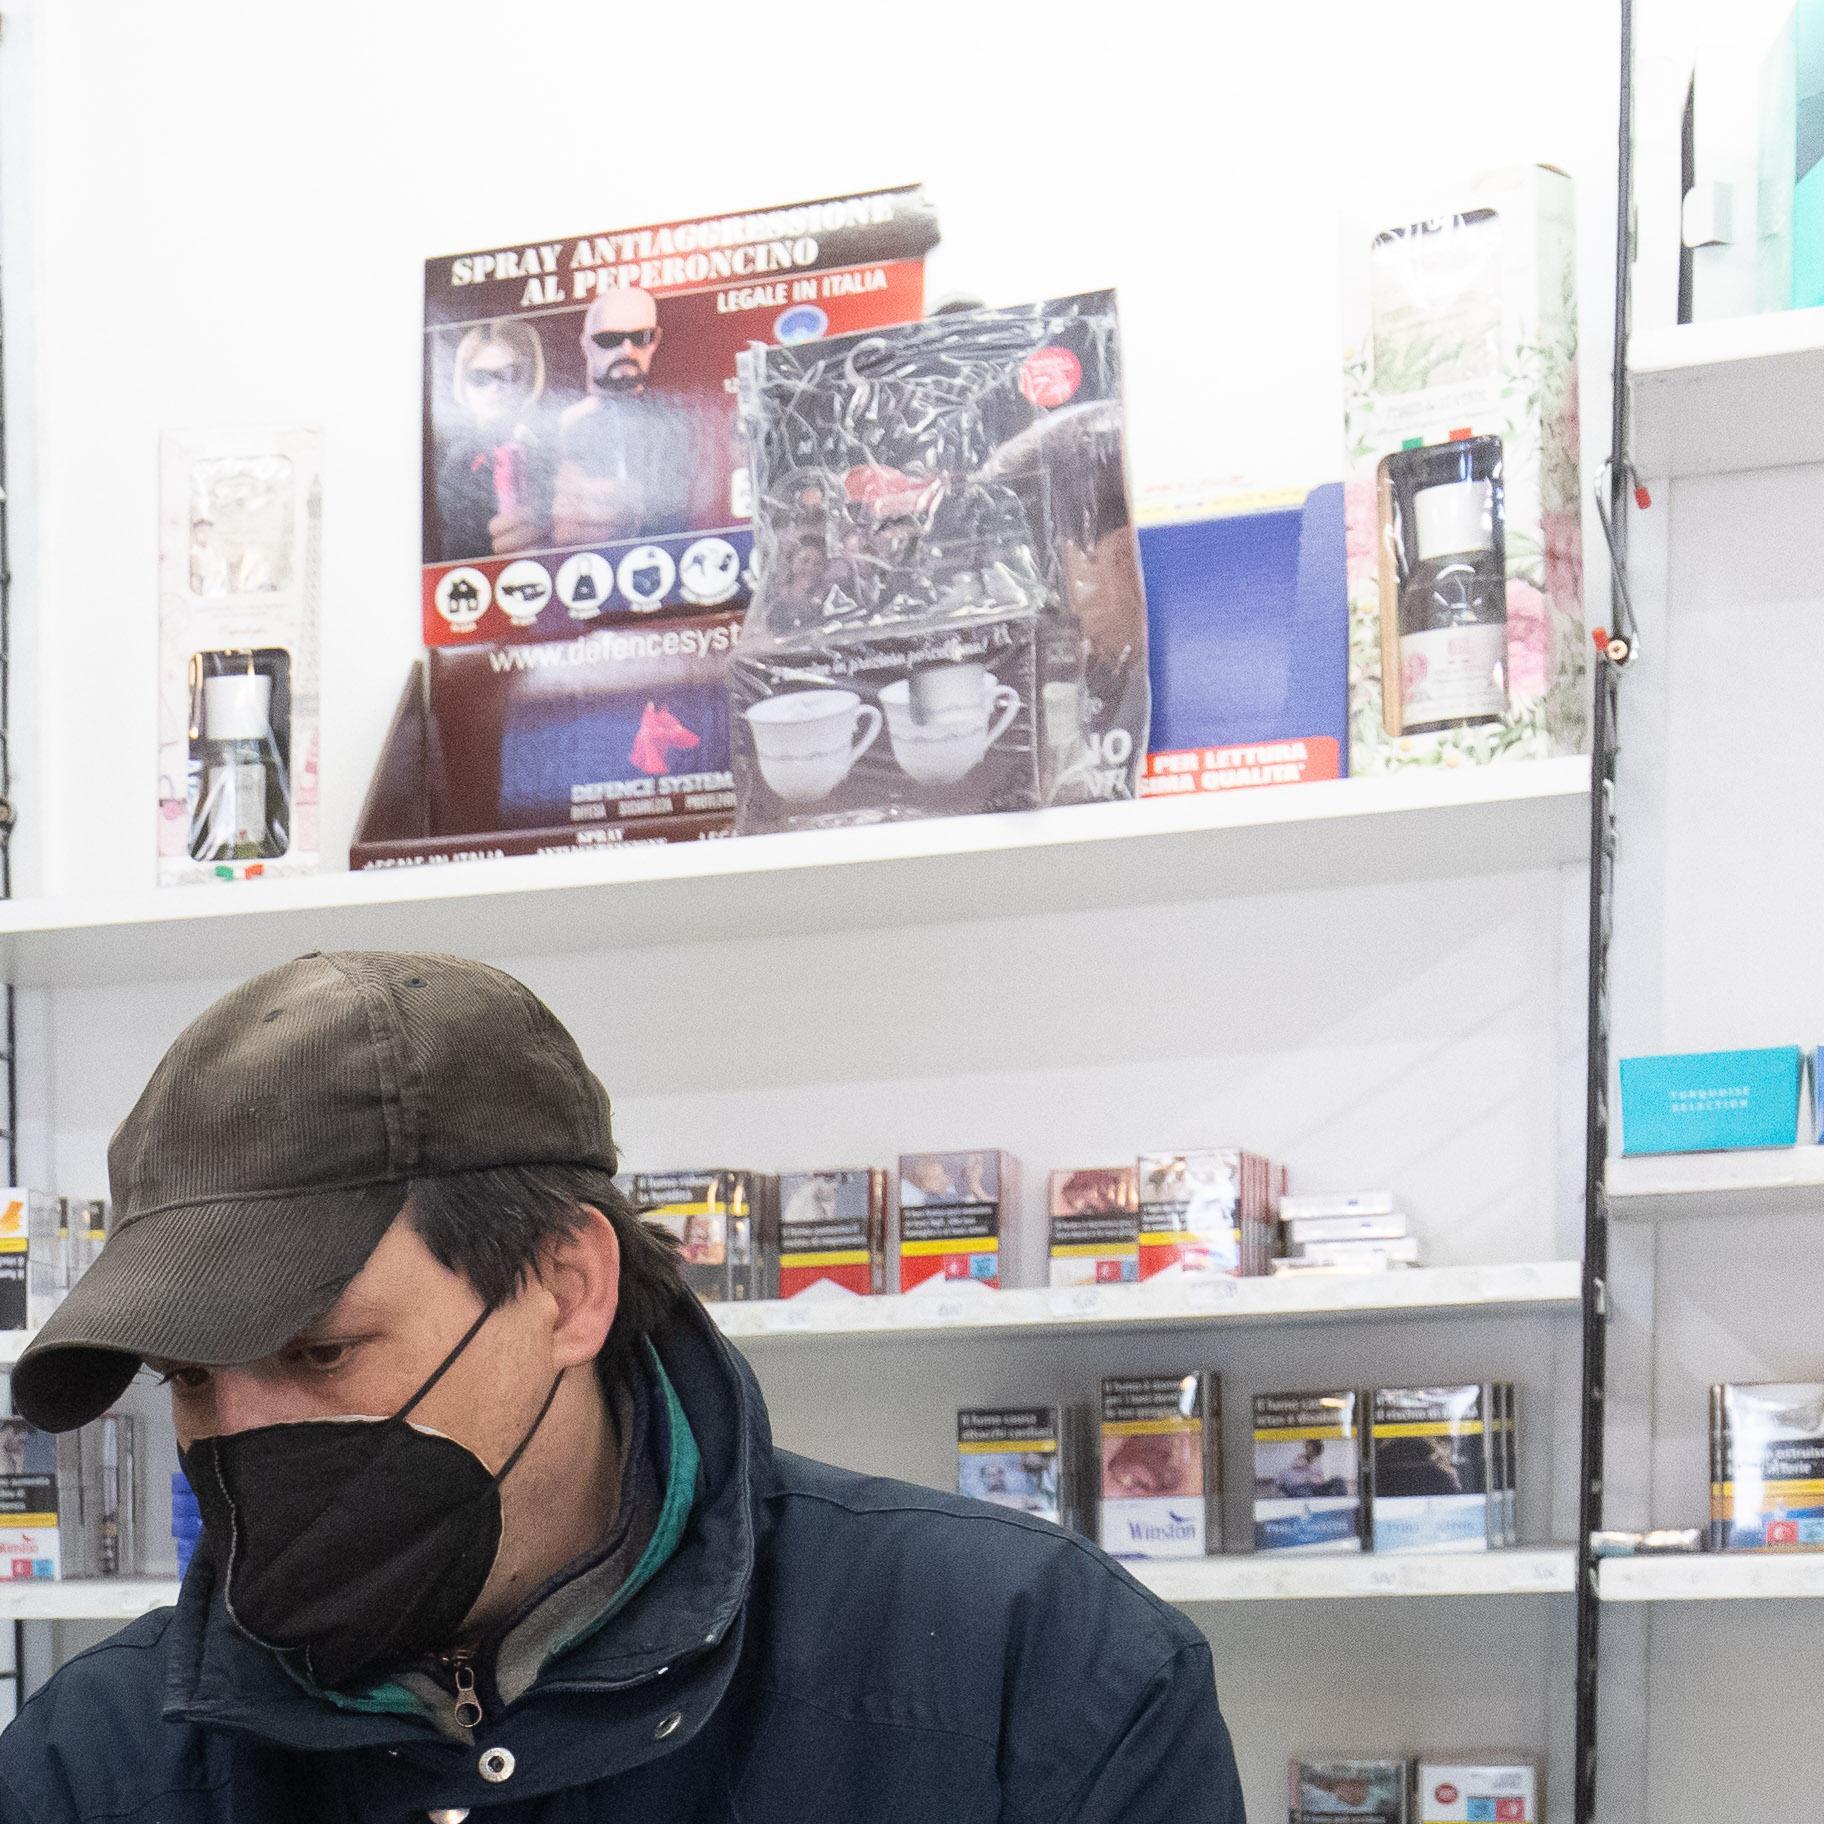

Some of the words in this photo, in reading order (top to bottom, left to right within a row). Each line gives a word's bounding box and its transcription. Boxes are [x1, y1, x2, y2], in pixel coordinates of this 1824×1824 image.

[453, 244, 561, 286] SPRAY
[522, 271, 564, 306] AL
[572, 237, 818, 300] PEPERONCINO
[717, 283, 789, 313] LEGALE
[793, 280, 818, 302] IN
[823, 269, 887, 299] ITALIA
[1154, 753, 1199, 773] PER
[1128, 1519, 1196, 1543] Winston
